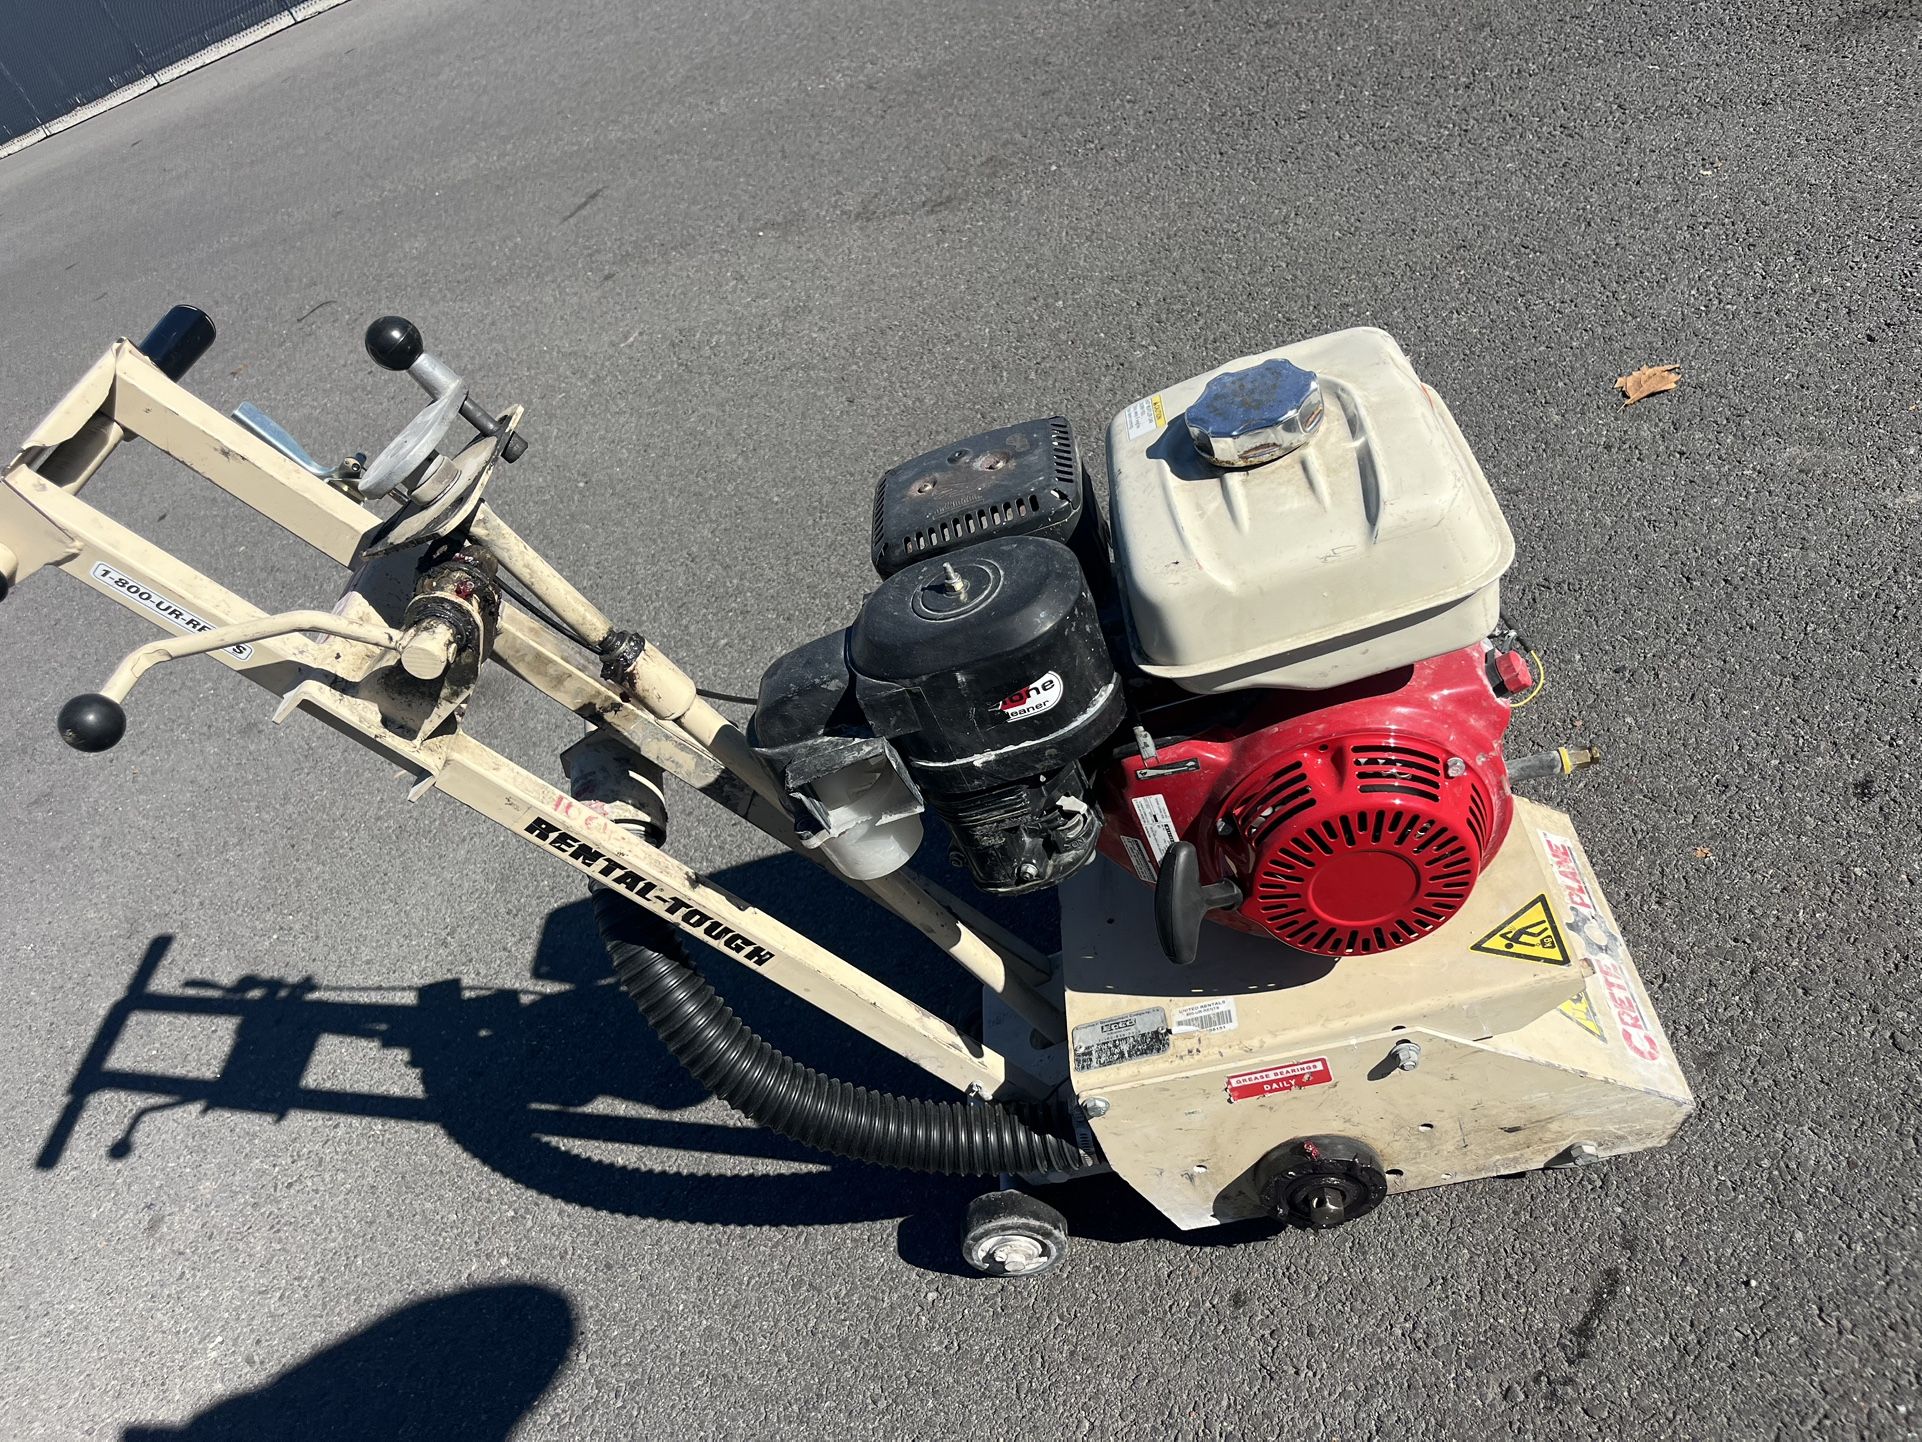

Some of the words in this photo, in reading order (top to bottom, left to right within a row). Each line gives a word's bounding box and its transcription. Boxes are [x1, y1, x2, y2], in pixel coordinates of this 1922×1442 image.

[100, 567, 247, 655] 1-800-UR-RES
[523, 815, 776, 967] RENTAL-TOUGH
[1545, 838, 1592, 909] PLANE
[1595, 957, 1659, 1061] CRETE
[1235, 1073, 1270, 1085] GREASE
[1273, 1063, 1318, 1077] BEARINGS
[1263, 1079, 1296, 1091] DAILY
